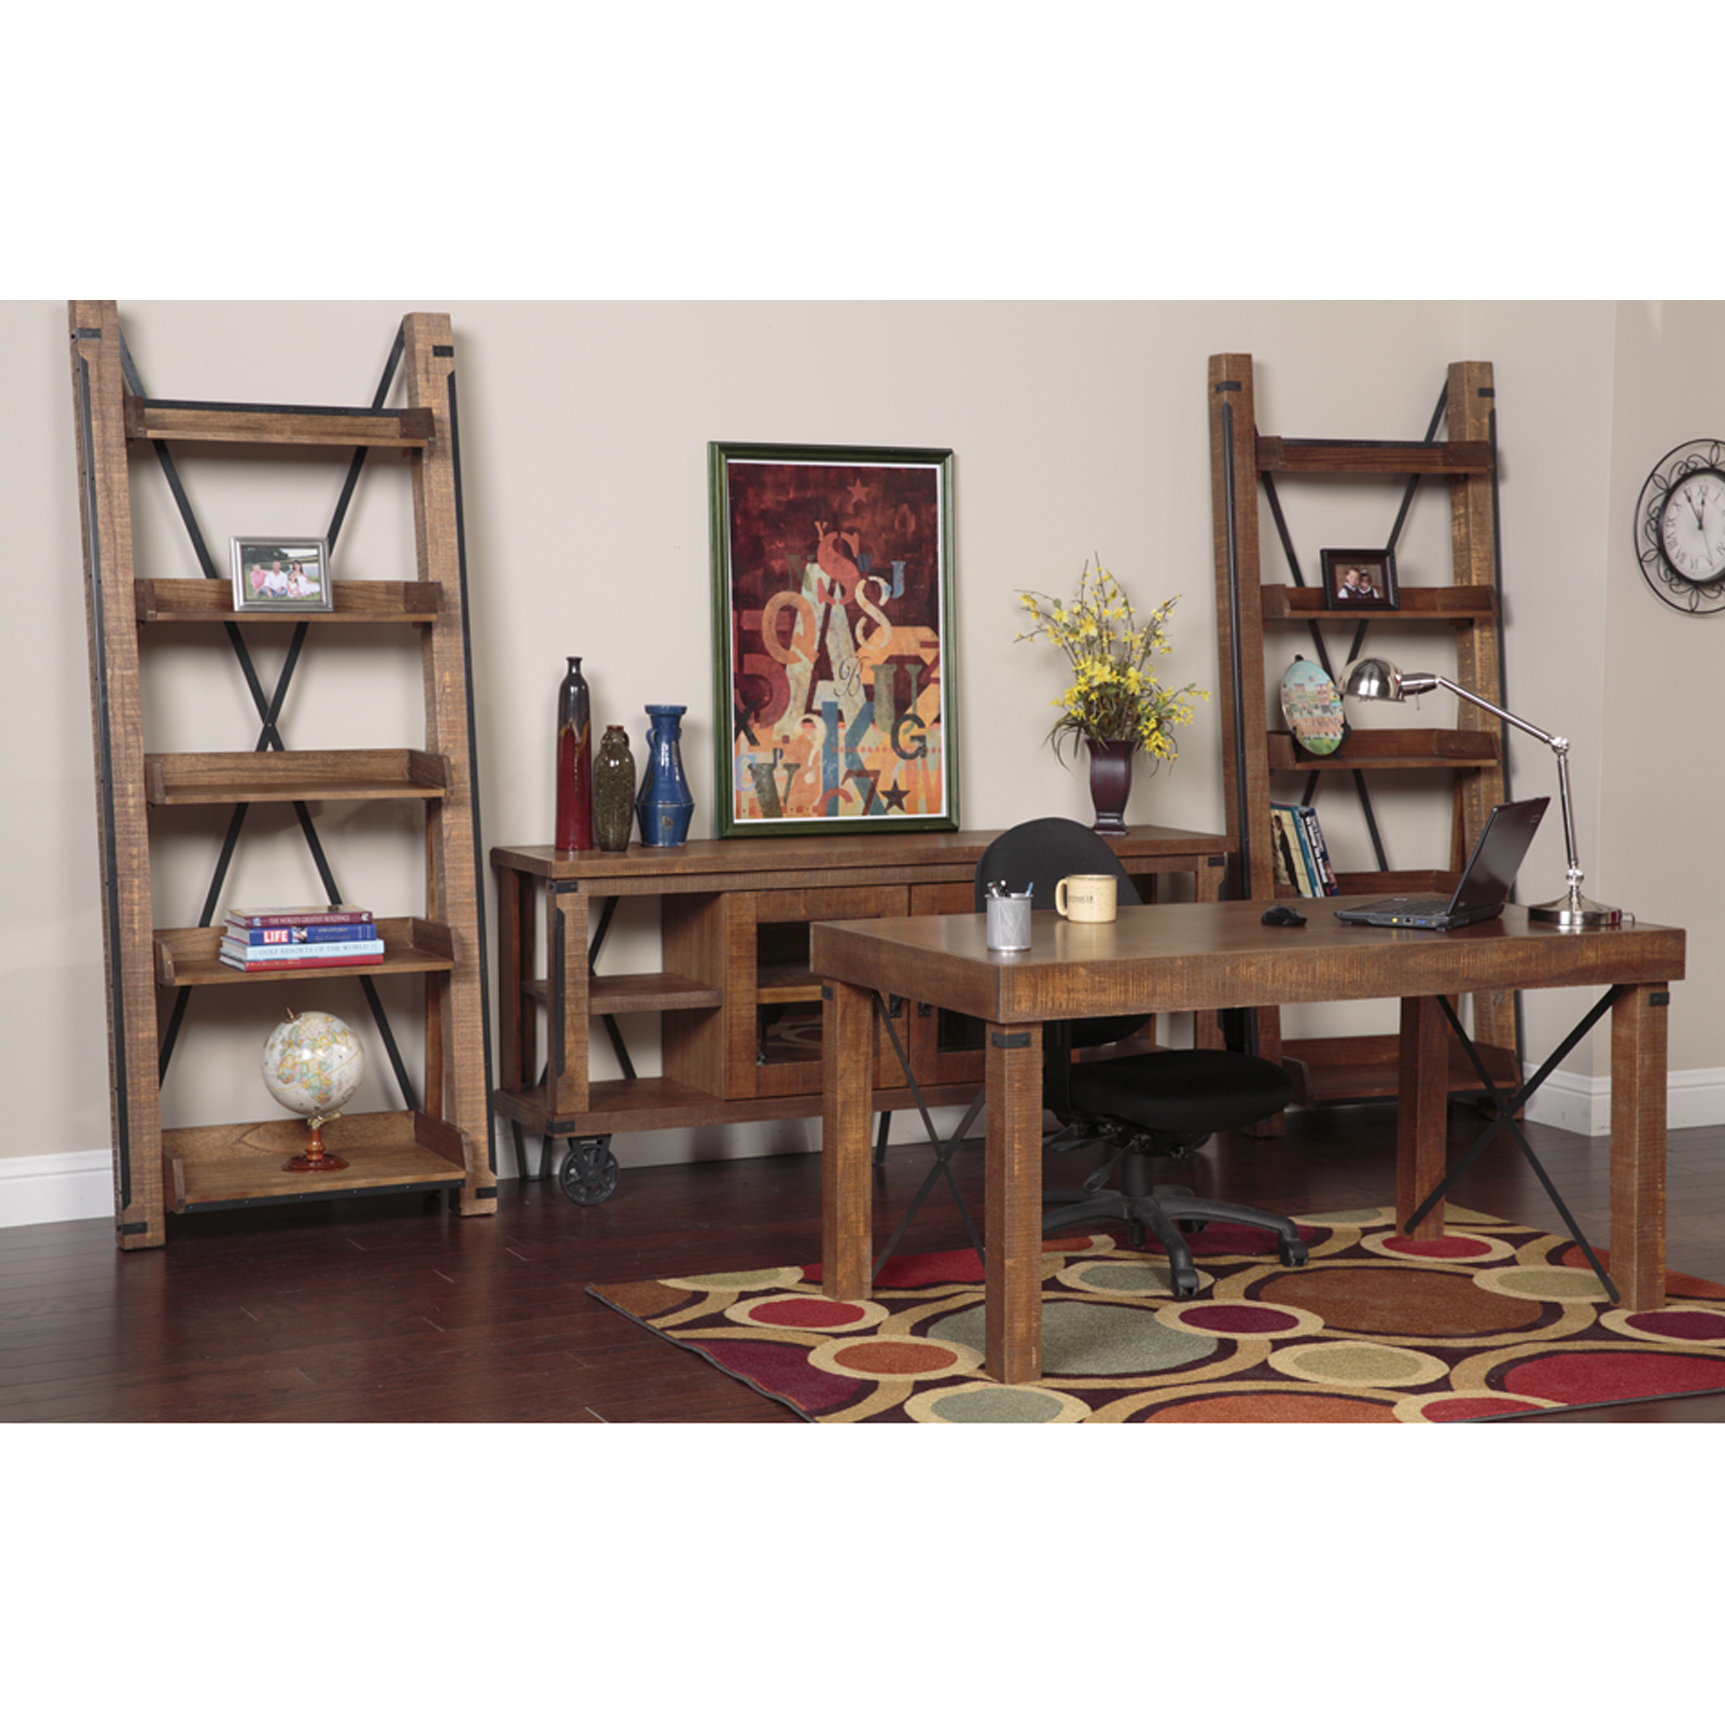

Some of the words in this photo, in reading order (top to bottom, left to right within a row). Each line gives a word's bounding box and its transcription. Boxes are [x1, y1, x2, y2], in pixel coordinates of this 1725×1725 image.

[817, 531, 861, 606] S
[762, 590, 820, 665] Q
[855, 575, 893, 650] S
[870, 663, 923, 735] U
[748, 763, 800, 818] V
[821, 701, 888, 818] K
[891, 713, 927, 760] G
[264, 930, 288, 943] LIFE
